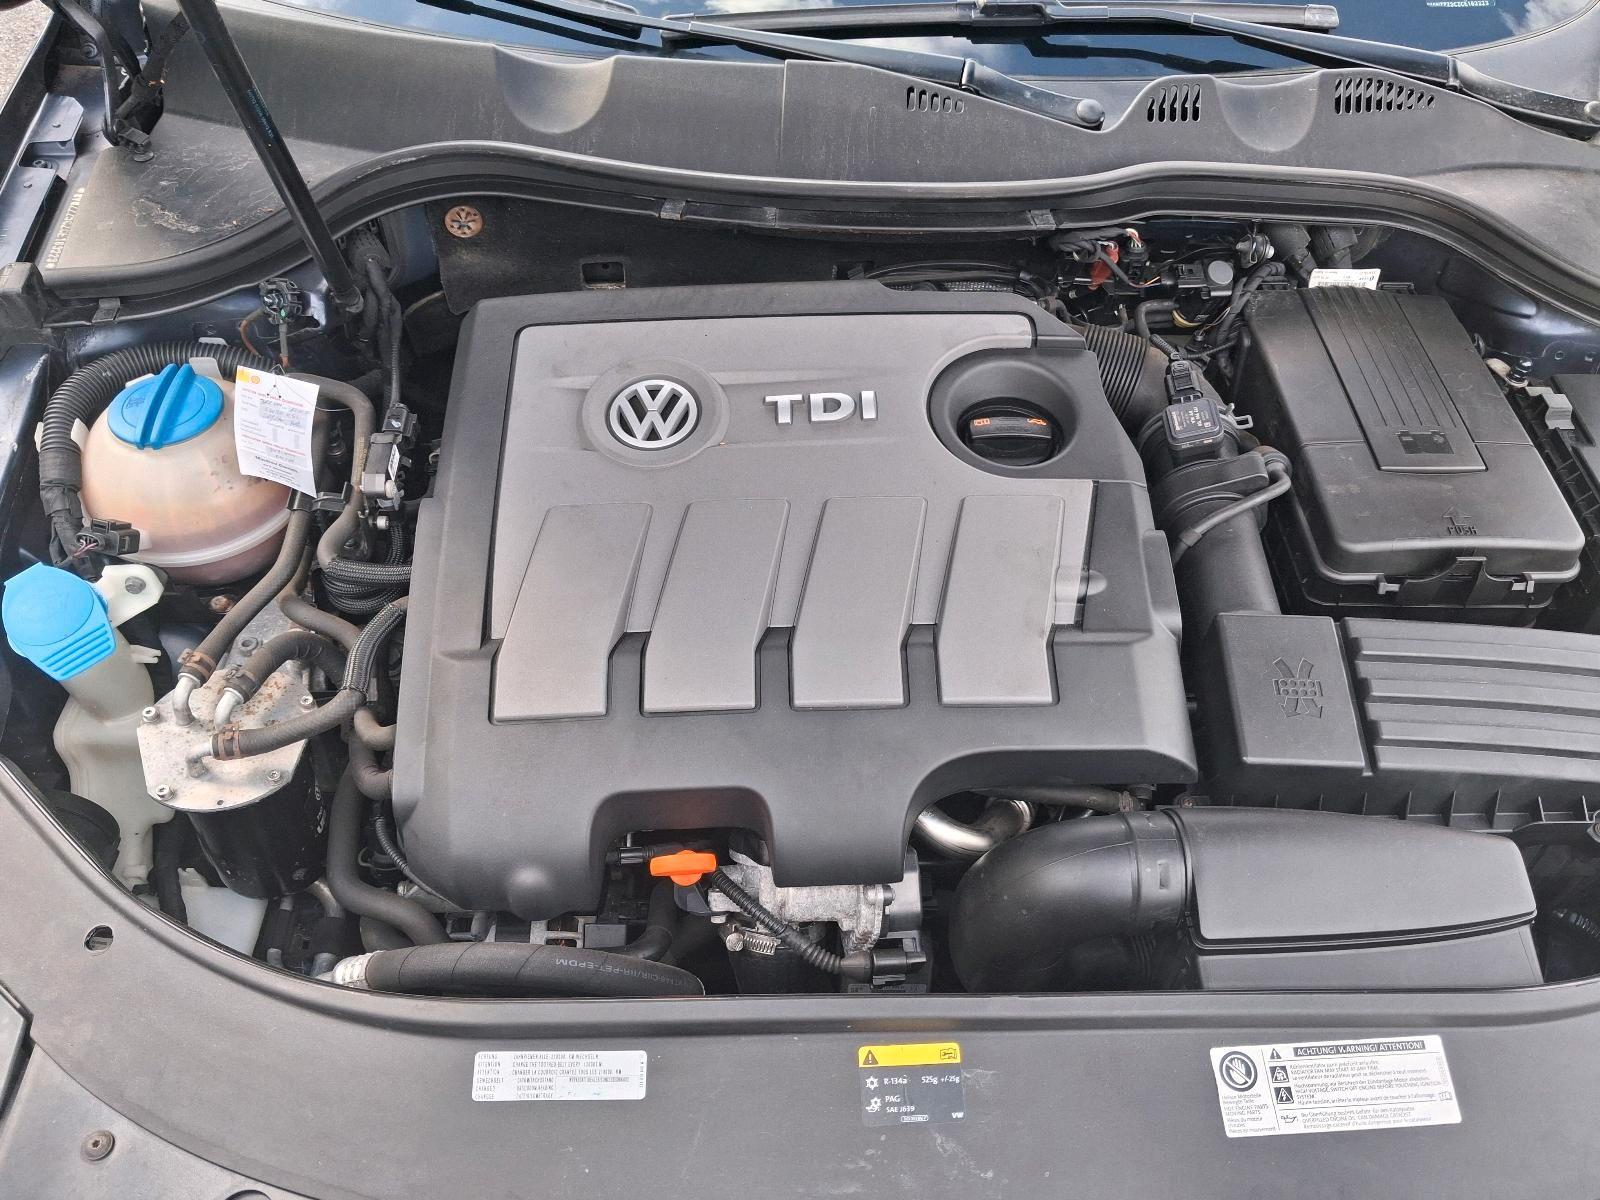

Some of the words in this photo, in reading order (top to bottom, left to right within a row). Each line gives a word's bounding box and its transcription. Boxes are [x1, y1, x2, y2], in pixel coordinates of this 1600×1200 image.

[764, 391, 878, 424] TDI
[1448, 526, 1478, 535] PUSH
[1297, 1046, 1336, 1056] ACHTUNG!
[1338, 1044, 1378, 1054] WARNING!
[1380, 1041, 1424, 1051] ATTENTION!
[884, 1077, 908, 1085] R-134a
[922, 1076, 938, 1084] 525g
